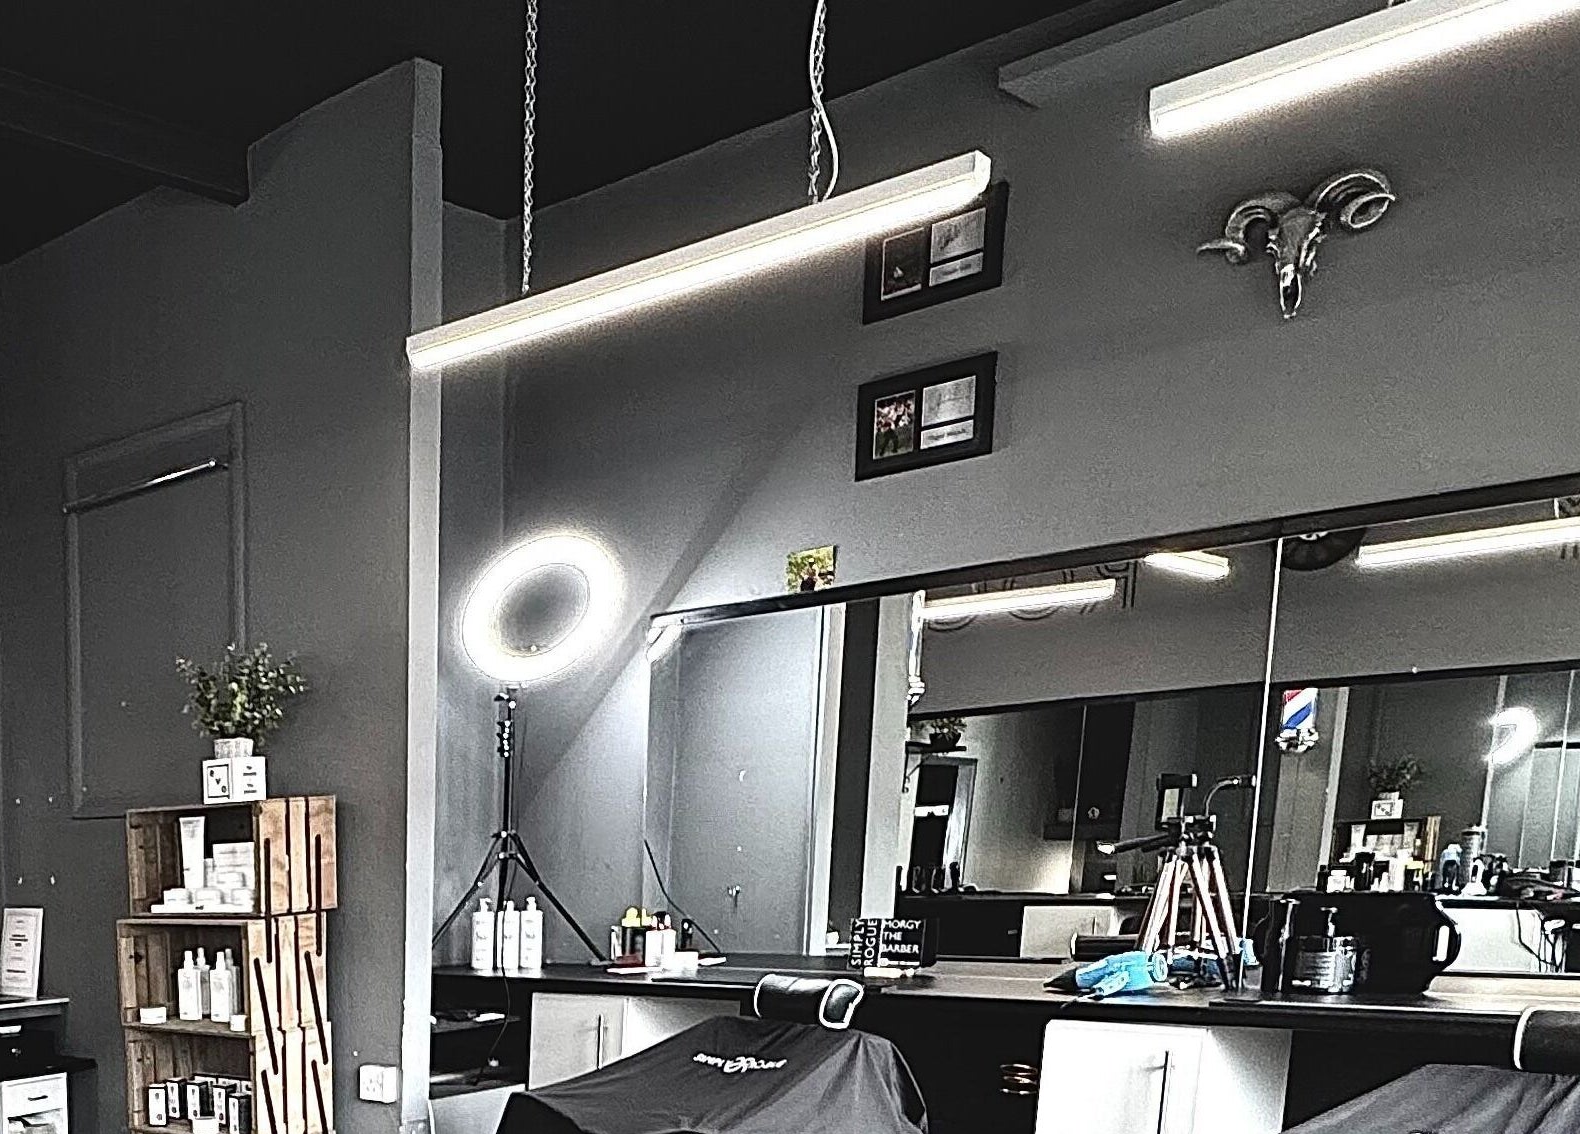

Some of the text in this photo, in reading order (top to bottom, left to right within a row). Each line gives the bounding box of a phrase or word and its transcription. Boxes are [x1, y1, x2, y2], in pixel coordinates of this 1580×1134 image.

[851, 919, 864, 966] SIMPLY
[864, 919, 878, 966] ROGUE
[882, 943, 919, 954] BARBER
[884, 931, 902, 941] THE
